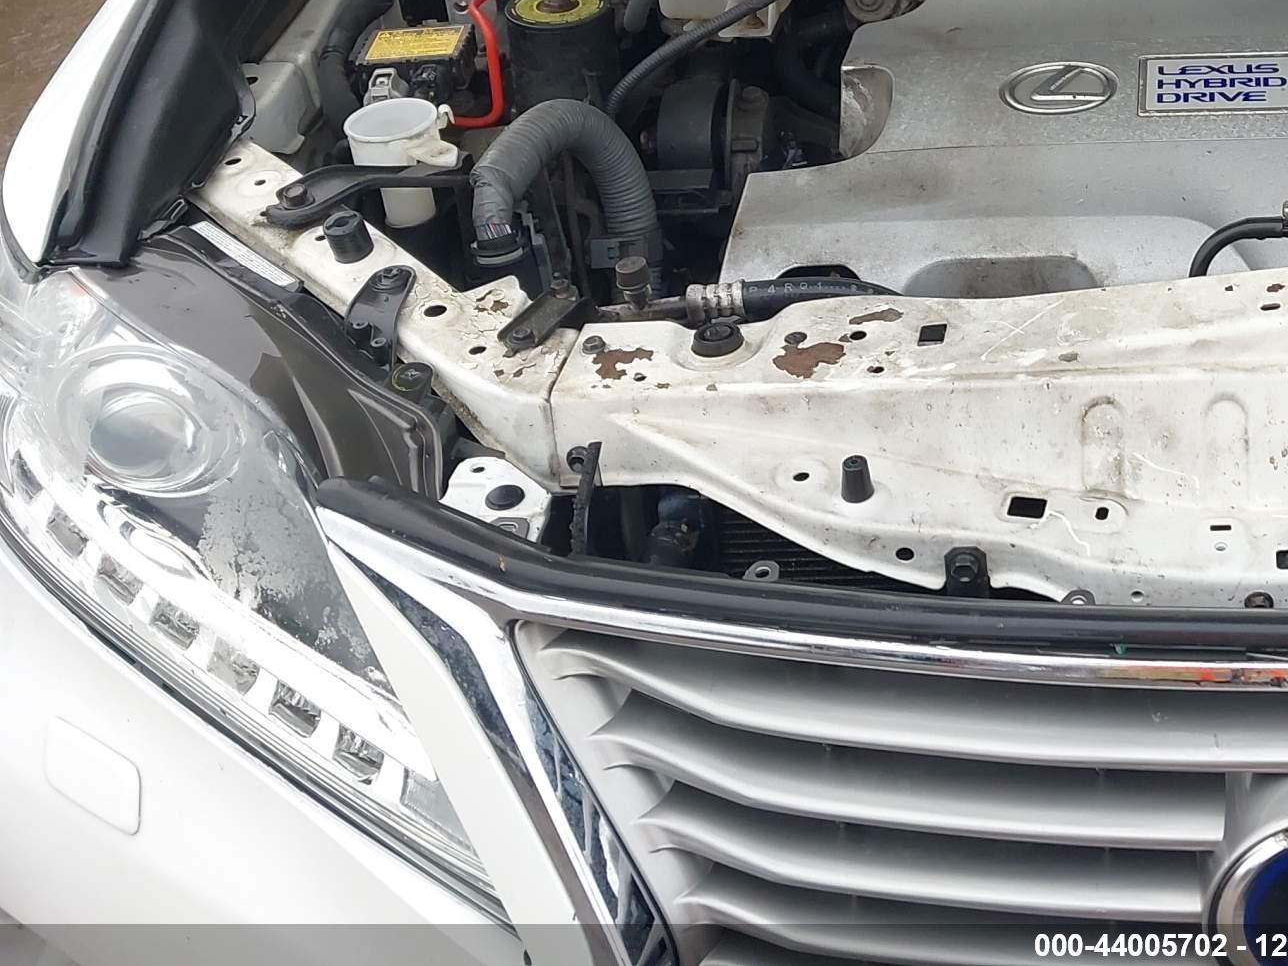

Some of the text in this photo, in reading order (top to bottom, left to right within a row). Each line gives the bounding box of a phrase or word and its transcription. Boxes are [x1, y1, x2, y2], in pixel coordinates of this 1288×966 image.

[1158, 63, 1279, 76] LEXUS
[1157, 77, 1287, 90] HYBRID
[1156, 90, 1267, 103] DRIVE
